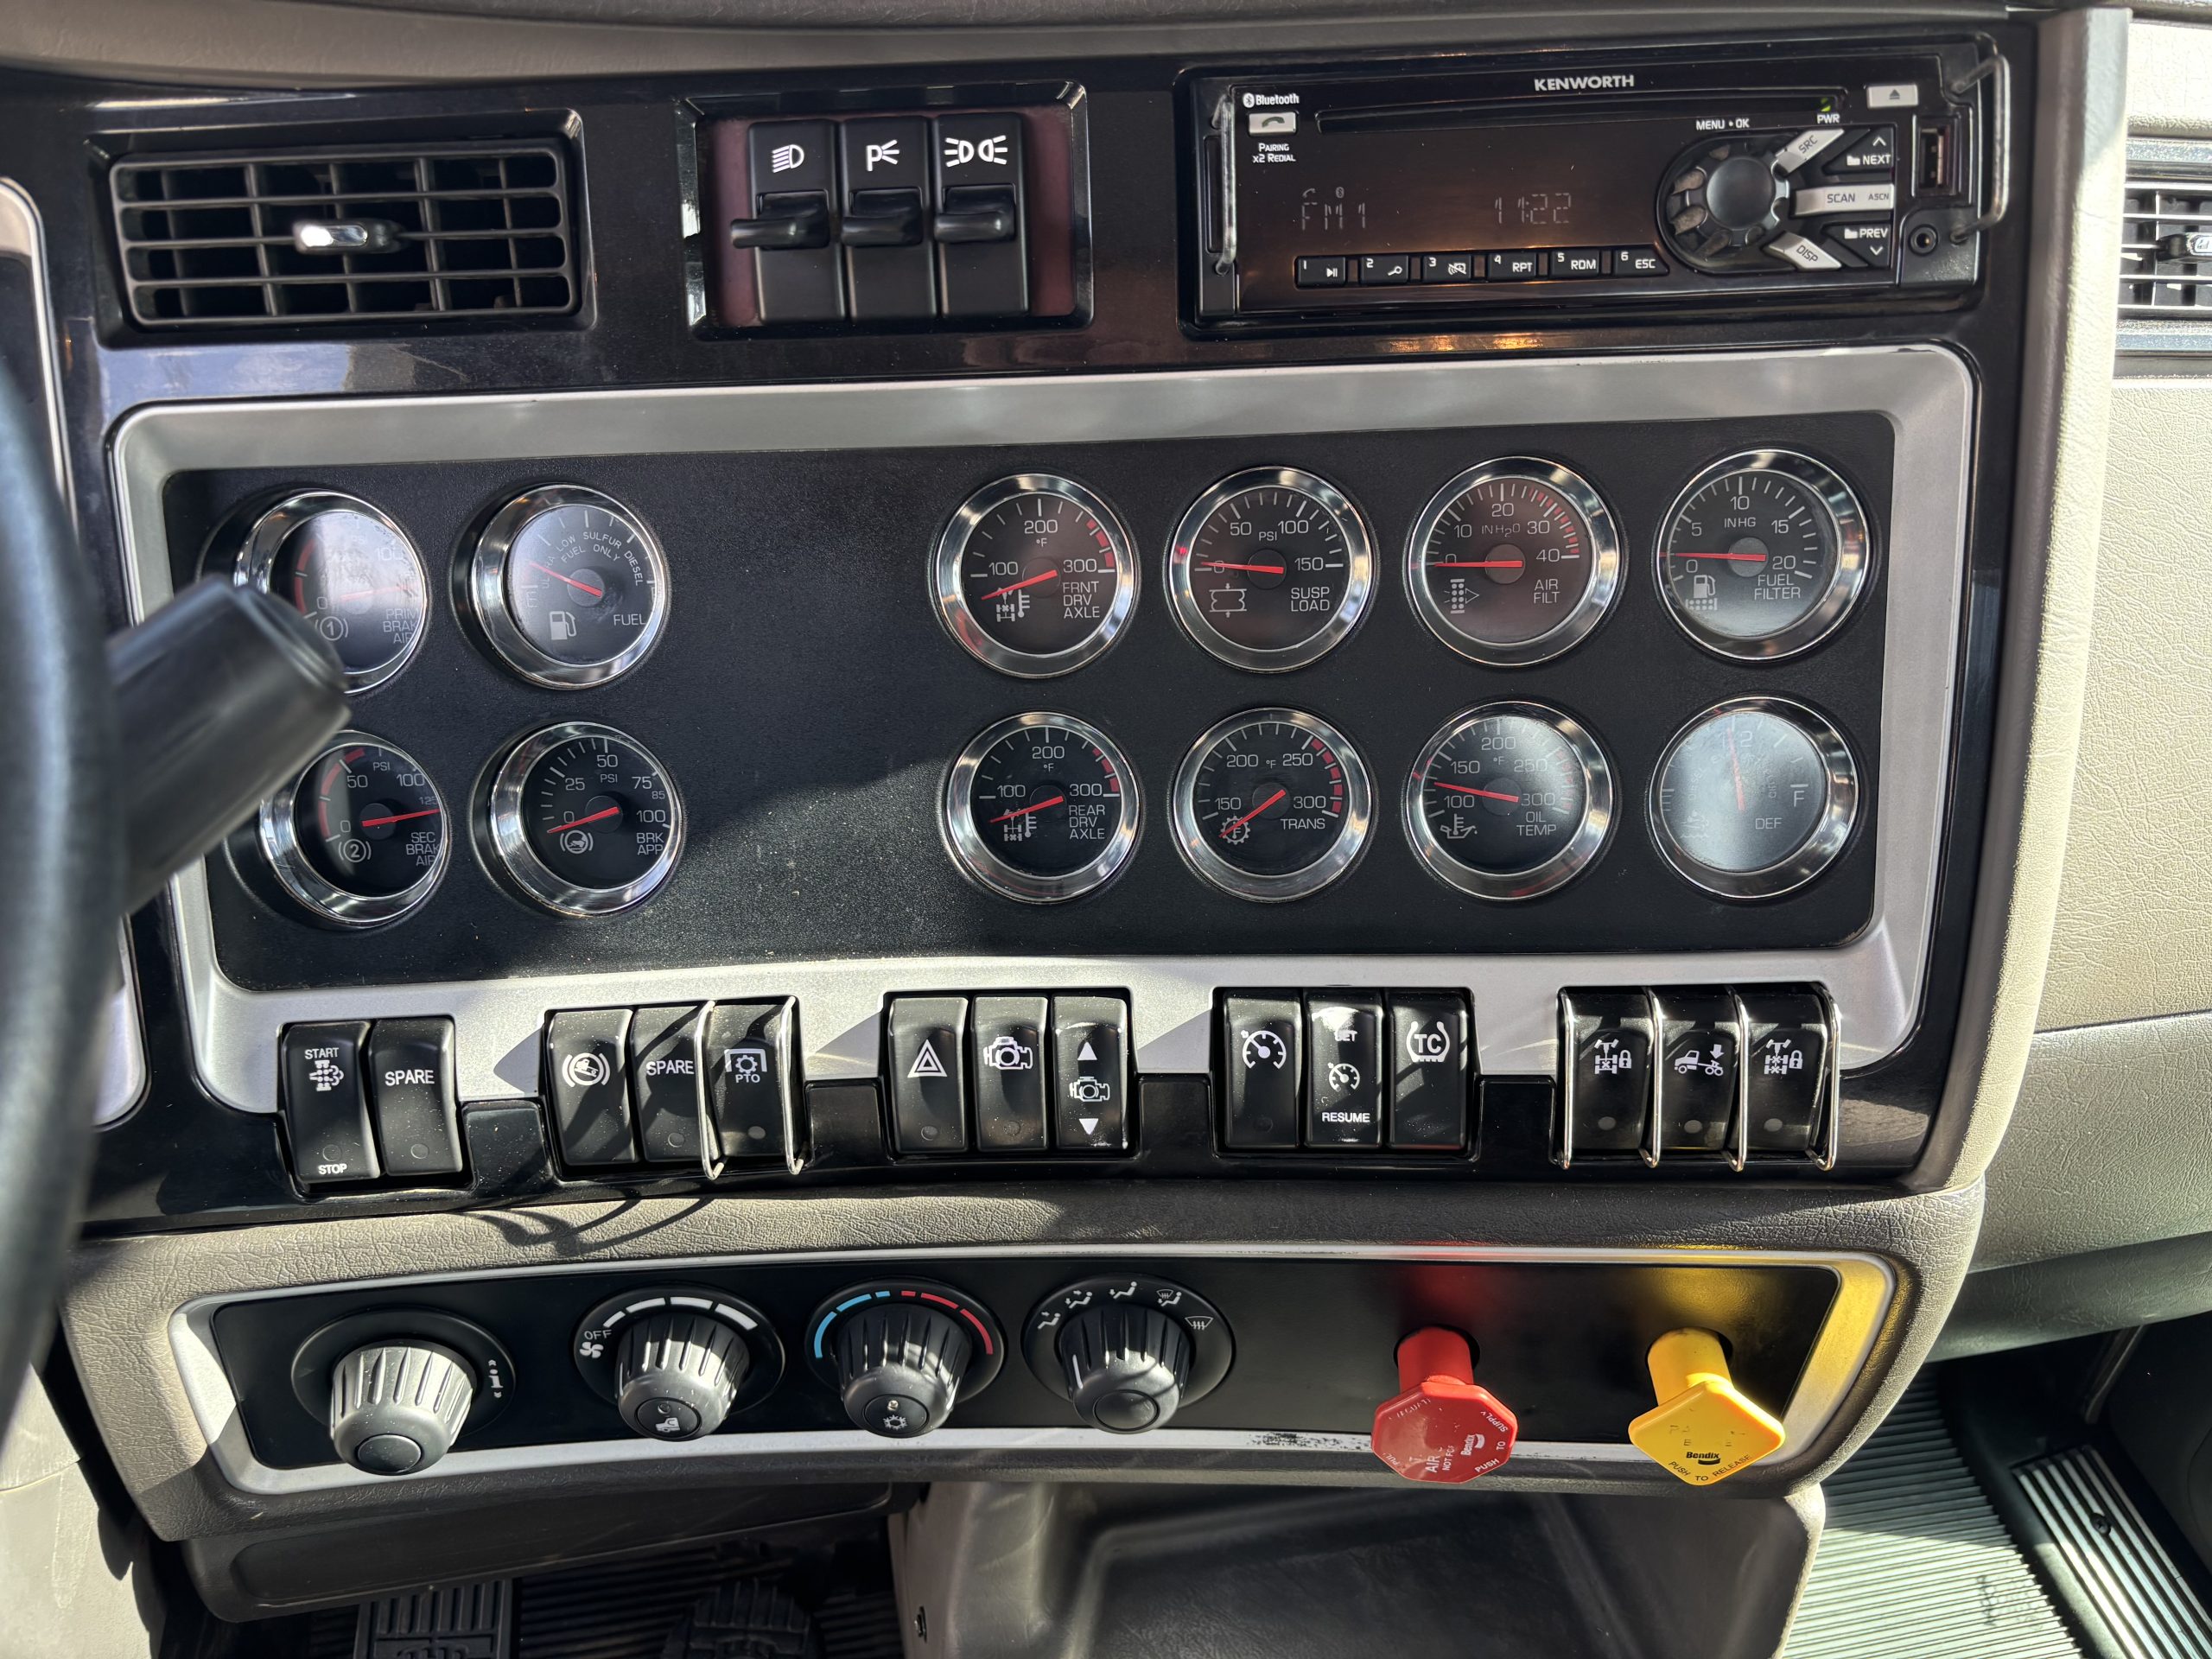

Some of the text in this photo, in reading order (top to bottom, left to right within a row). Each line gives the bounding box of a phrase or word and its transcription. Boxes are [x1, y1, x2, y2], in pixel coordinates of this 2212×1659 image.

[1534, 75, 1634, 92] KENWORTH
[1255, 93, 1299, 105] Bluetooth
[1696, 118, 1750, 130] MENU OK
[1817, 114, 1840, 124] PWR
[1798, 135, 1818, 154] SRC
[1862, 155, 1891, 164] NEXT
[1827, 194, 1856, 203] SCAN
[1495, 192, 1571, 225] 11:22
[1859, 228, 1888, 238] PREV
[1494, 256, 1502, 264] 4
[1557, 253, 1565, 262] 5
[1621, 252, 1629, 261] 6
[1796, 245, 1818, 262] DISP
[1366, 259, 1374, 268] 2
[1428, 257, 1437, 267] 3
[1512, 263, 1532, 273] RPT
[1571, 259, 1596, 270] RDM
[1635, 259, 1656, 269] ESC
[1730, 496, 1750, 510] 10
[1491, 503, 1514, 517] 20
[1024, 520, 1058, 534] 200
[1230, 520, 1309, 541] 50 PSI 100
[1453, 524, 1472, 537] 10
[1527, 520, 1550, 534] 30
[1691, 522, 1702, 537] 5
[1771, 519, 1789, 534] 15
[1036, 538, 1047, 547] °F
[556, 535, 576, 553] LOW
[583, 531, 622, 550] SULFUR
[623, 550, 644, 586] DIESEL
[561, 544, 620, 563] FUEL ONLY
[1536, 549, 1560, 563] 40
[988, 562, 1019, 575] 100
[1063, 559, 1097, 573] 300
[1213, 560, 1224, 574] 0
[1294, 557, 1324, 571] 150
[1686, 559, 1698, 573] 0
[1772, 555, 1796, 569] 20
[1535, 579, 1558, 590] AIR
[1758, 574, 1795, 587] FUEL
[1063, 582, 1099, 594] FRNT
[1291, 587, 1330, 599] SUSP
[1754, 587, 1801, 601] FILTER
[1063, 594, 1092, 607] DRV
[1534, 591, 1560, 603] FILT
[1291, 600, 1330, 612] LOAD
[1064, 607, 1100, 619] AXLE
[613, 614, 646, 626] FUEL
[1481, 737, 1516, 751] 200
[1032, 746, 1065, 759] 200
[596, 754, 619, 767] 50
[1226, 754, 1259, 767] 200
[1282, 753, 1313, 766] 250
[1451, 759, 1548, 774] 150 250
[373, 762, 390, 772] PSI
[1043, 763, 1054, 772] °F
[346, 773, 425, 788] 50 100
[564, 777, 652, 791] 25 75
[600, 773, 618, 783] PSI
[652, 791, 665, 799] 85
[997, 785, 1027, 798] 100
[1069, 784, 1103, 797] 300
[1215, 798, 1242, 810] 150
[1293, 796, 1326, 809] 300
[1443, 795, 1475, 808] 100
[1521, 793, 1555, 806] 300
[1793, 791, 1804, 807] F
[563, 810, 575, 823] 0
[636, 810, 666, 823] 100
[1069, 804, 1105, 816] REAR
[1069, 817, 1097, 828] DRV
[1525, 811, 1546, 823] OIL
[1755, 817, 1783, 830] DEF
[340, 821, 352, 833] 0
[1280, 818, 1325, 830] TRANS
[1516, 824, 1557, 836] TEMP
[410, 831, 436, 843] SEC
[636, 832, 664, 843] BRK
[1069, 828, 1105, 839] AXLE
[637, 844, 664, 855] APP
[1414, 1033, 1442, 1054] TC
[305, 1047, 339, 1059] START
[645, 1059, 695, 1076] SPARE
[385, 1069, 435, 1086] SPARE
[735, 1073, 760, 1084] PTO
[1322, 1111, 1370, 1123] RESUME
[318, 1163, 347, 1175] STOP
[584, 1329, 612, 1340] OFF
[1460, 1433, 1477, 1456] Bendix
[1475, 1410, 1509, 1472] PUSH TO SUPPLY
[1426, 1455, 1440, 1473] AIR
[1442, 1457, 1452, 1471] NOT
[1669, 1461, 1691, 1476] PUSH
[1713, 1454, 1752, 1477] RELEASE
